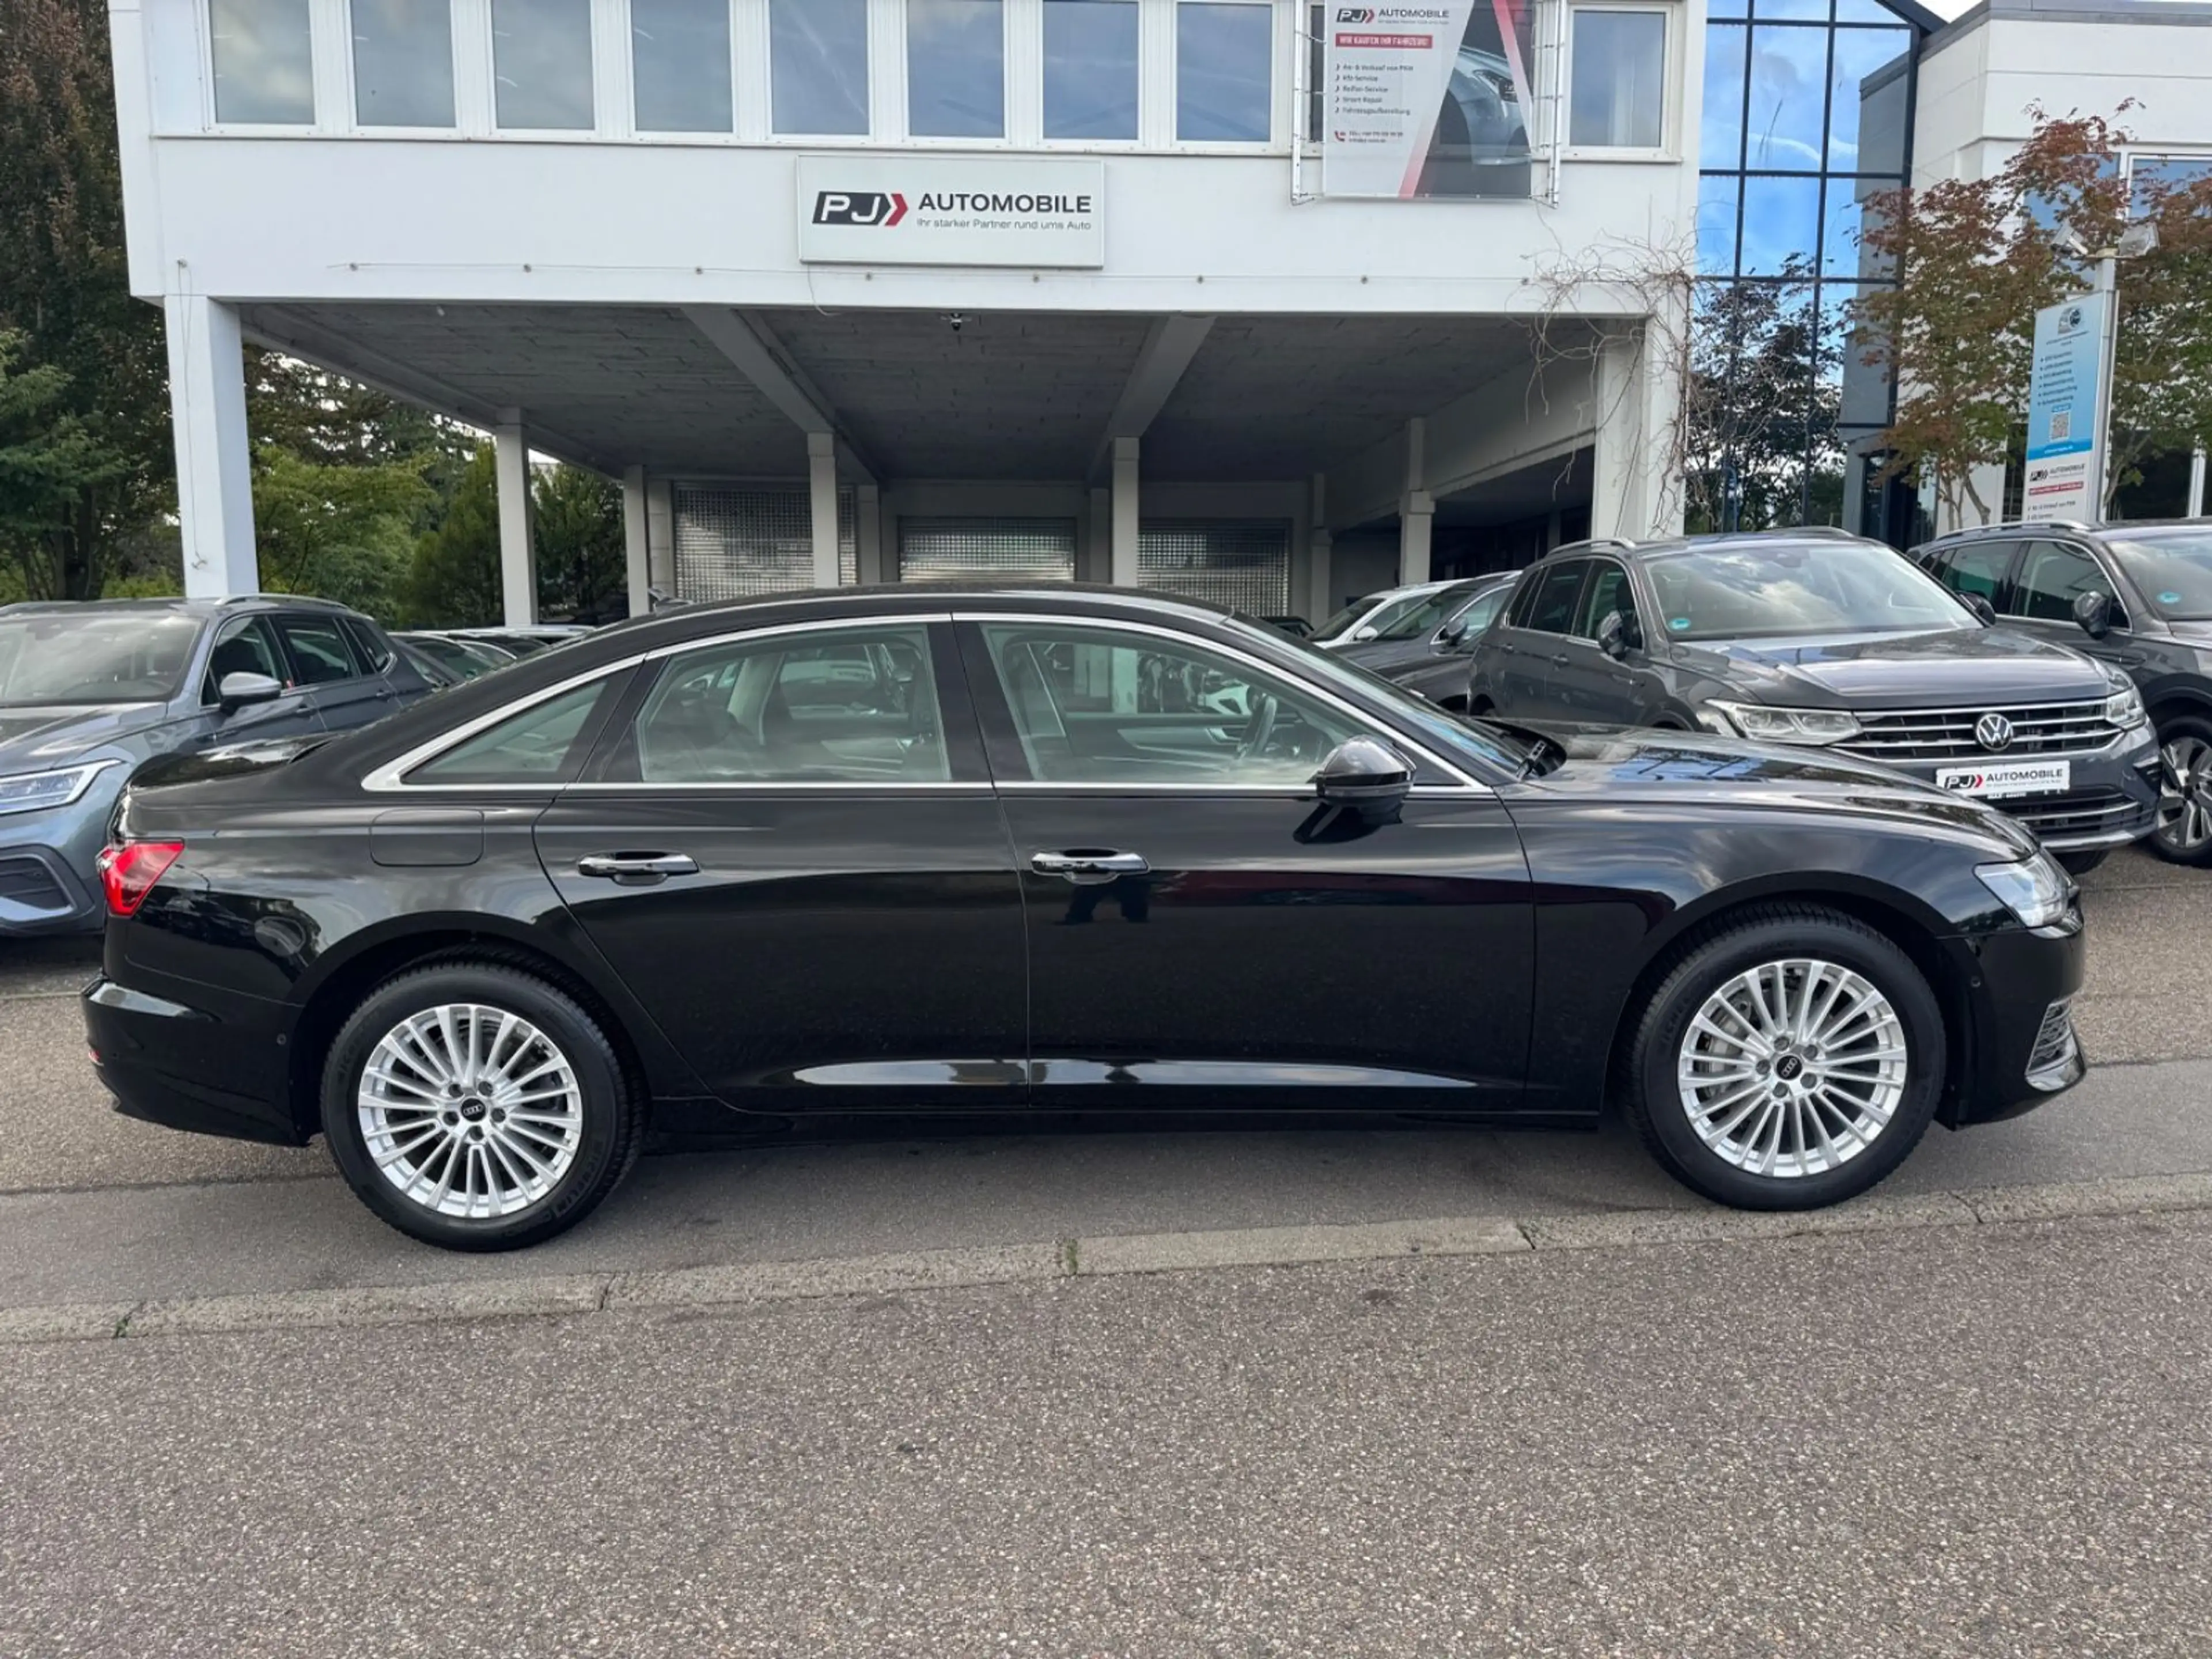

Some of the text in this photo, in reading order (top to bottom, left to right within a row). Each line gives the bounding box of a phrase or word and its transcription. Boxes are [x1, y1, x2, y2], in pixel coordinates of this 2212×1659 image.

[1378, 8, 1449, 18] AUTOMOBILE
[918, 193, 1092, 213] AUTOMOBILE
[917, 218, 1092, 230] Ihr starker Partner rund ums Auto
[1986, 768, 2063, 782] AUTOMOBILE
